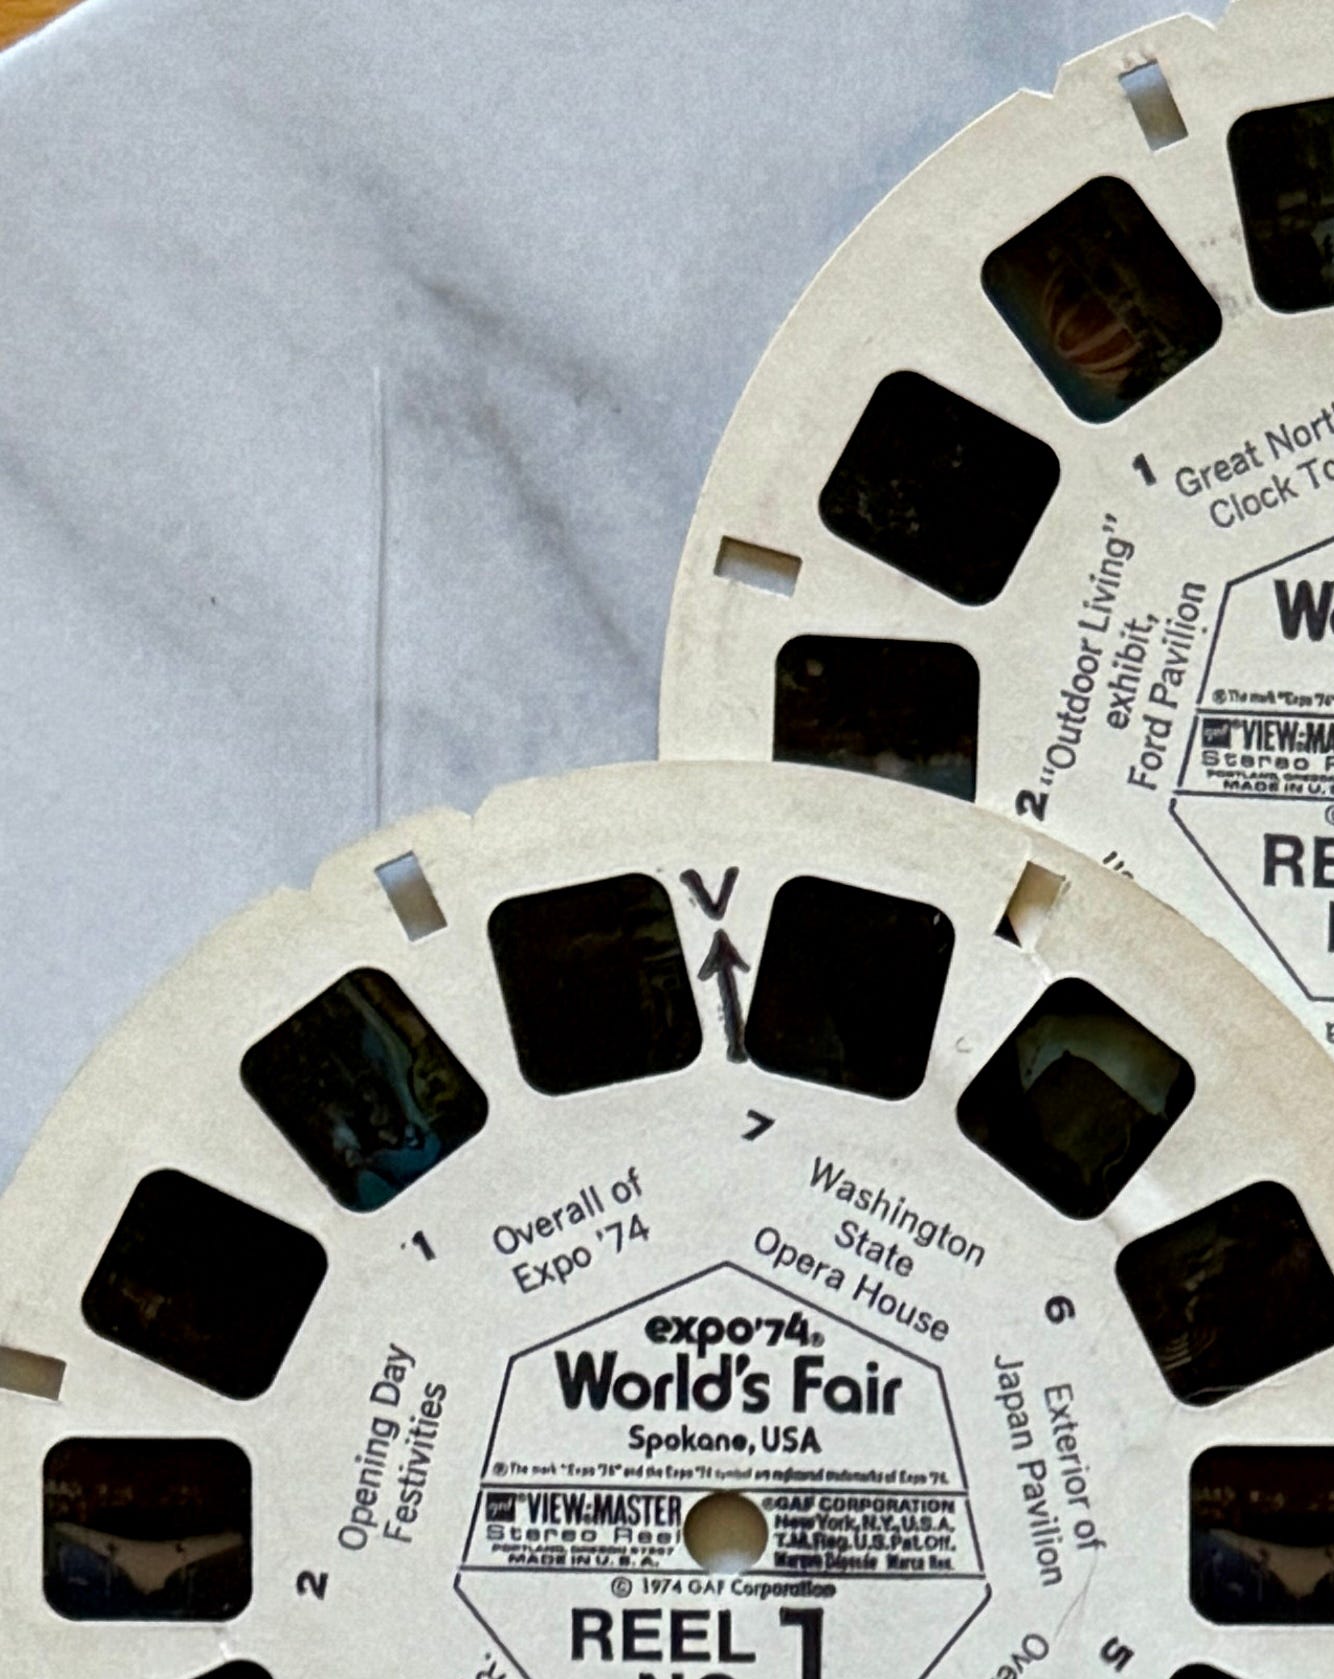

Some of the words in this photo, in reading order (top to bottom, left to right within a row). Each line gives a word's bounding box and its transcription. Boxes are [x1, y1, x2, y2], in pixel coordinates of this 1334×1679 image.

[1175, 440, 1264, 497] Great
[1209, 474, 1299, 528] Clock
[1201, 749, 1309, 771] Stereo
[1220, 779, 1279, 794] MADE
[1283, 782, 1303, 793] IN
[681, 867, 738, 919] V
[492, 1184, 604, 1254] Overall
[610, 1166, 642, 1204] of
[809, 1155, 985, 1267] Washington
[411, 1230, 436, 1261] 1
[511, 1245, 591, 1293] Expo
[834, 1219, 913, 1277] State
[754, 1226, 845, 1291] Opera
[851, 1273, 949, 1342] House
[554, 1350, 769, 1413] World's
[792, 1355, 902, 1414] Fair
[628, 1424, 755, 1458] Spokane,
[761, 1425, 821, 1453] USA
[571, 1607, 755, 1662] REEL
[1099, 1635, 1134, 1672] 5
